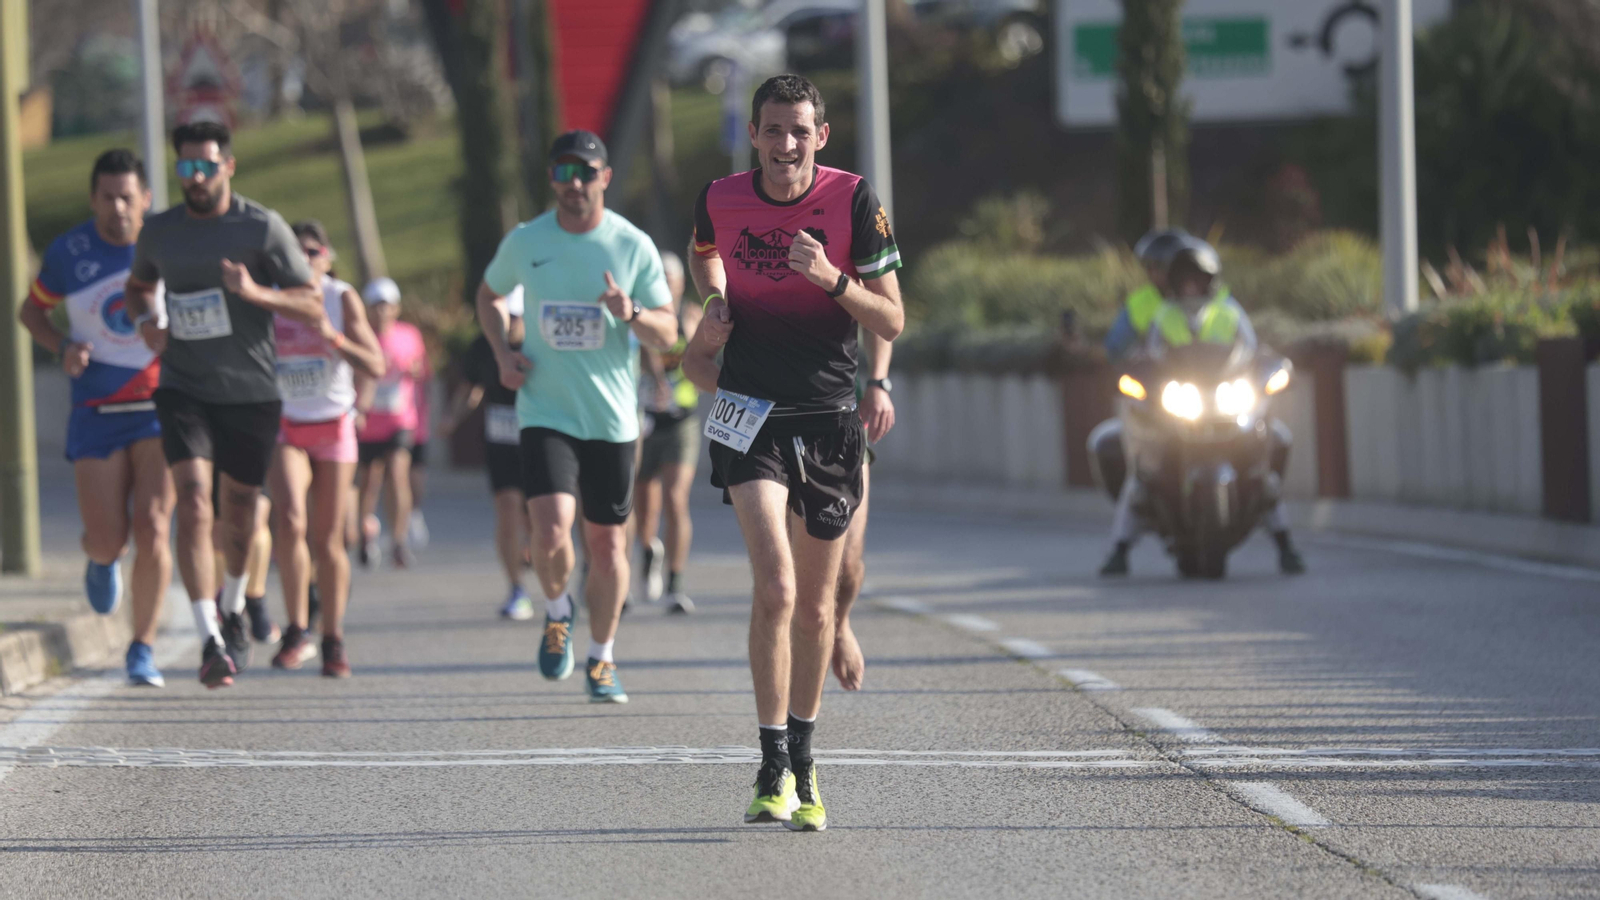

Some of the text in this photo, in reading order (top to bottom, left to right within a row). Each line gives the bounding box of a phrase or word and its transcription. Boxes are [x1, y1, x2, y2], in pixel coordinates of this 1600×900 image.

[740, 261, 789, 270] TRA
[554, 316, 585, 337] 205
[708, 425, 731, 441] EVOS
[816, 512, 847, 528] Sevilla
